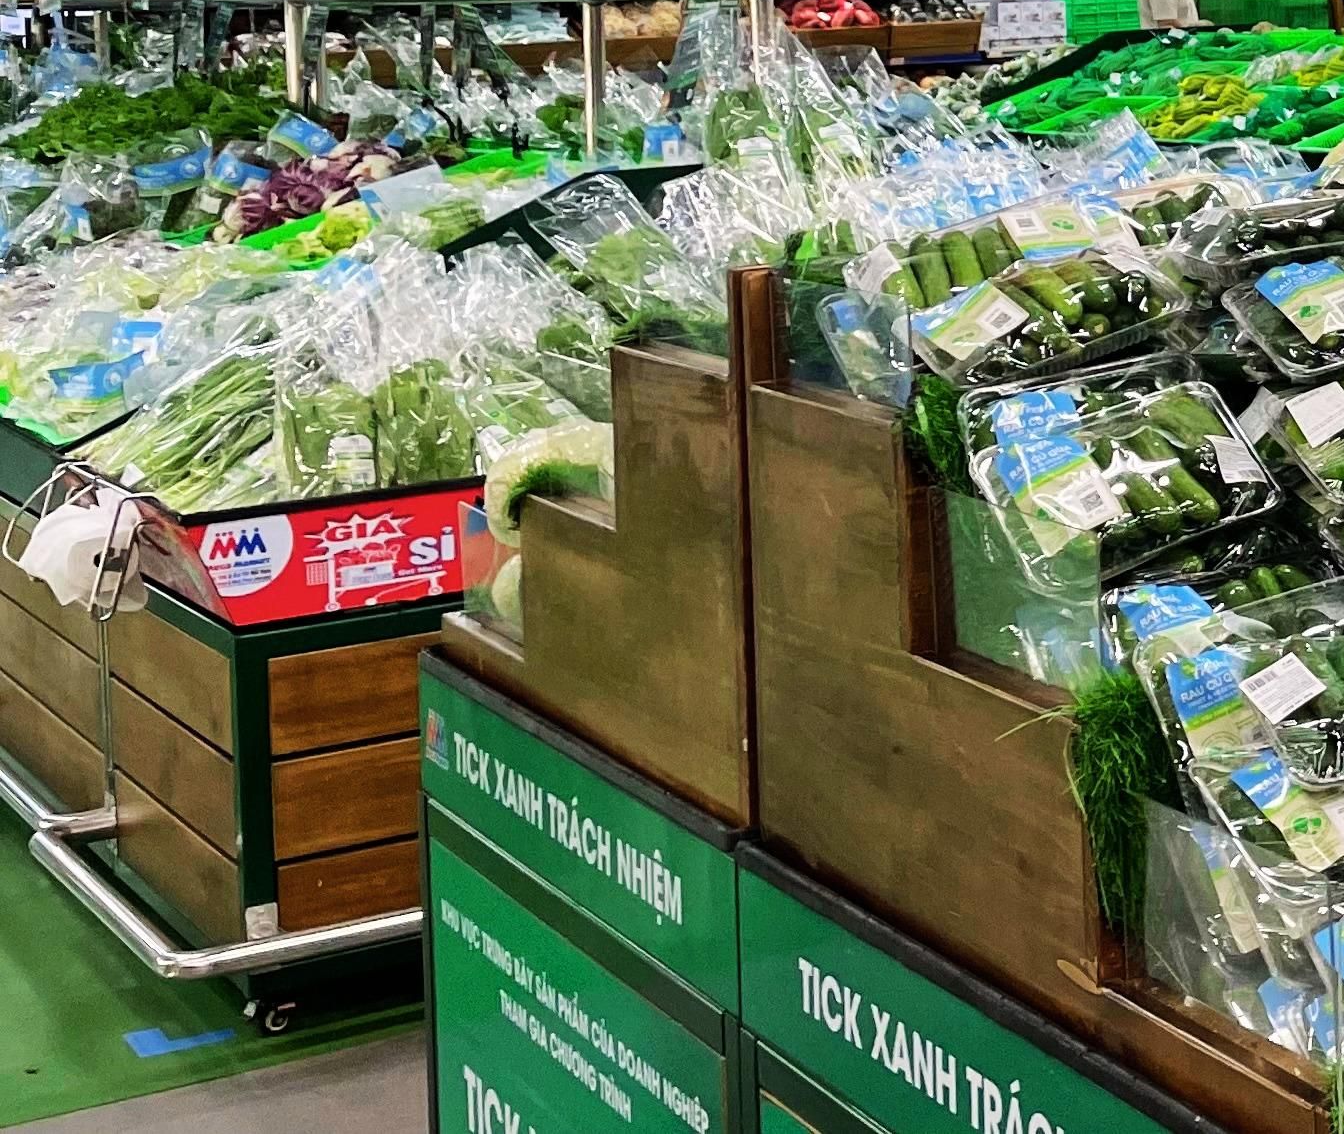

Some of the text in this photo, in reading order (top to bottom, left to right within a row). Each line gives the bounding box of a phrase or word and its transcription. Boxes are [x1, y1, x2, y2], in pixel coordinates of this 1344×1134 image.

[453, 732, 684, 926] TICK XANH TRÁCH NHIỆM
[440, 898, 461, 935] KHU
[512, 955, 534, 996] BÀY
[535, 970, 557, 1010] SẢN
[591, 1017, 616, 1059] CỦA
[618, 1035, 660, 1097] DOANH
[499, 988, 632, 1123] THAM GIA CHƯƠNG TRÌNH
[798, 956, 959, 1114] TICK XANH
